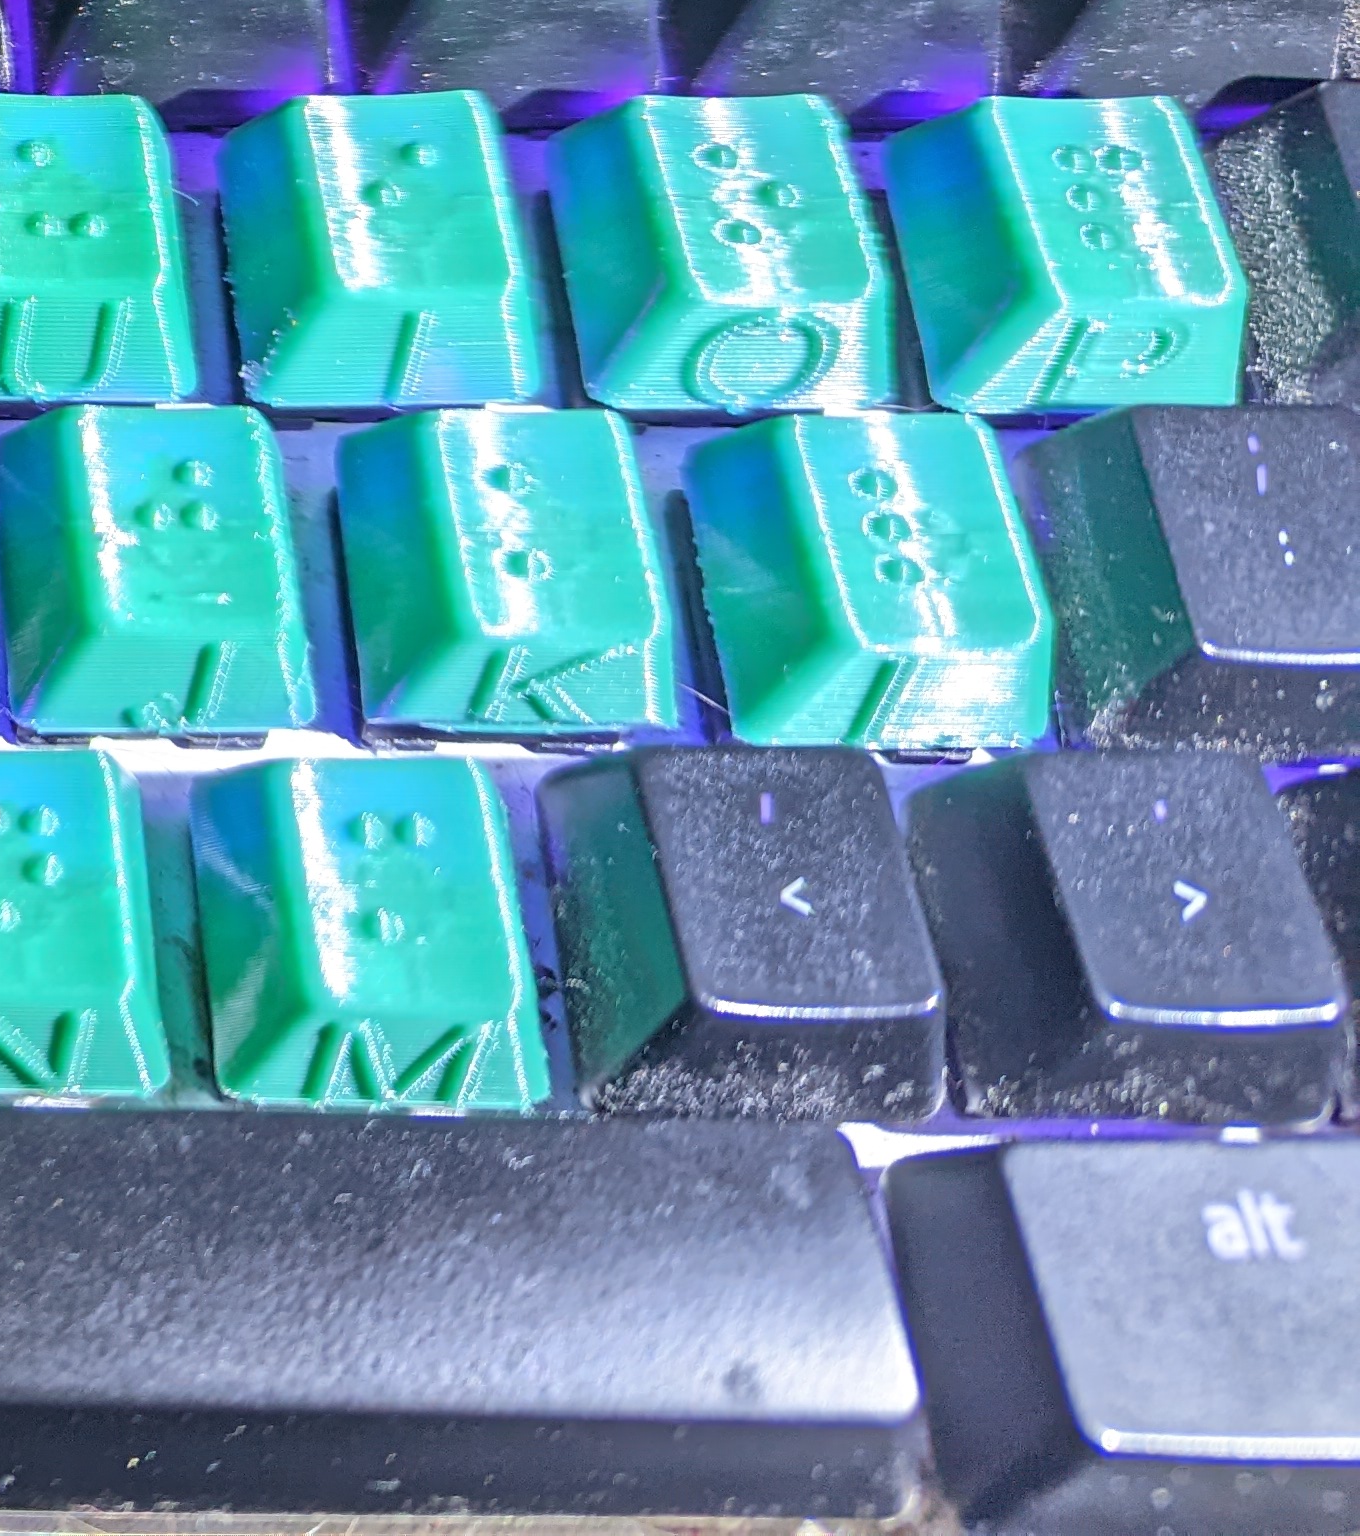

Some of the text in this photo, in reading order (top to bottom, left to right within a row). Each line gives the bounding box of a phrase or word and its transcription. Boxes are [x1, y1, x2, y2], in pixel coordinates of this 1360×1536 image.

[121, 639, 238, 732] J
[467, 642, 638, 726] K
[313, 1018, 500, 1111] M
[1201, 1190, 1307, 1262] alt
